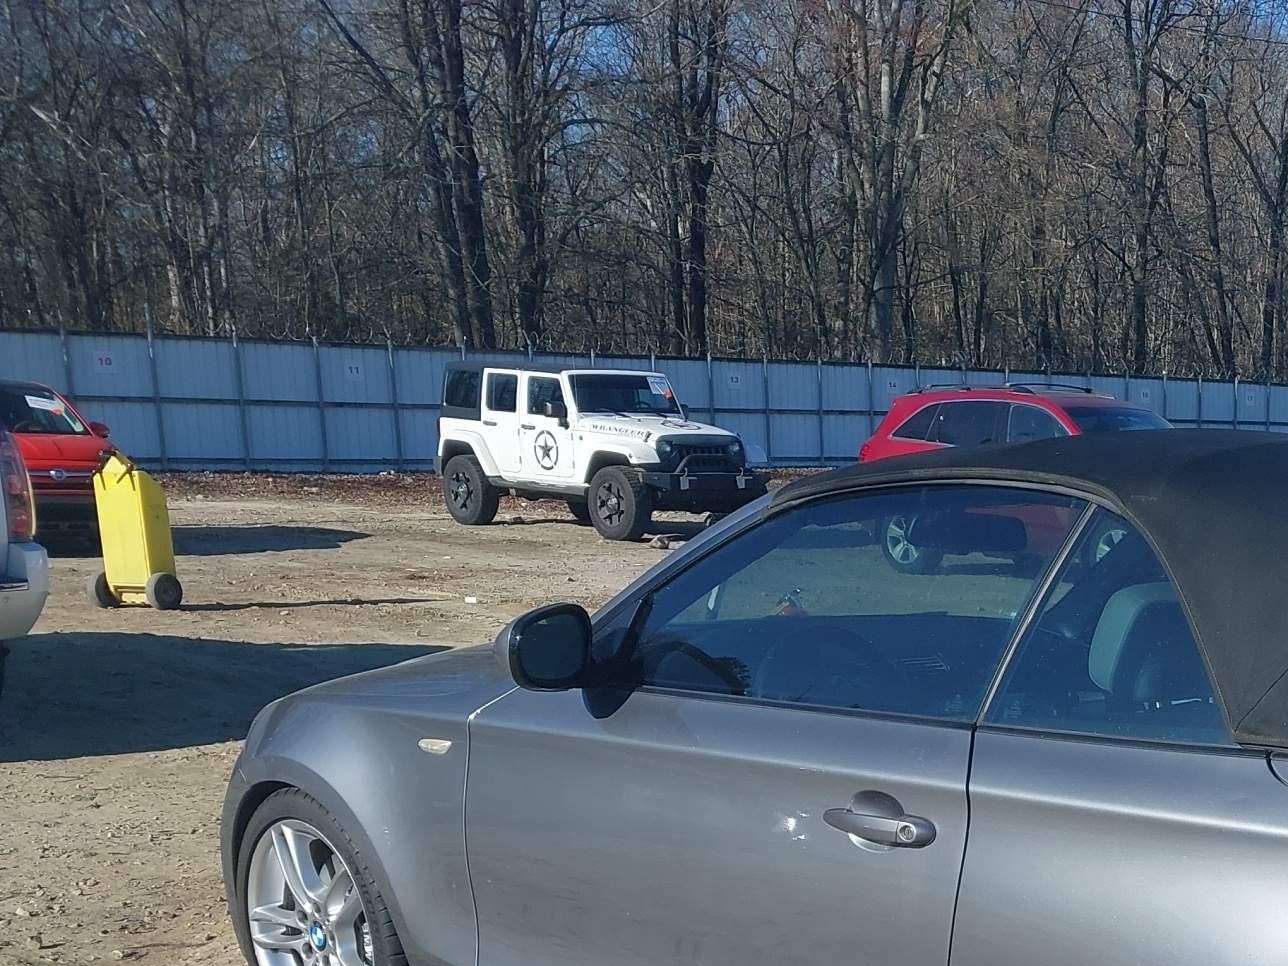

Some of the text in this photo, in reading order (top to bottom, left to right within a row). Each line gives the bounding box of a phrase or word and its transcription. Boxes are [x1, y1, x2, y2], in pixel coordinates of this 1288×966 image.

[97, 356, 113, 367] 10
[348, 366, 361, 375] 11
[730, 376, 740, 384] 13
[592, 424, 645, 436] WRANGLER
